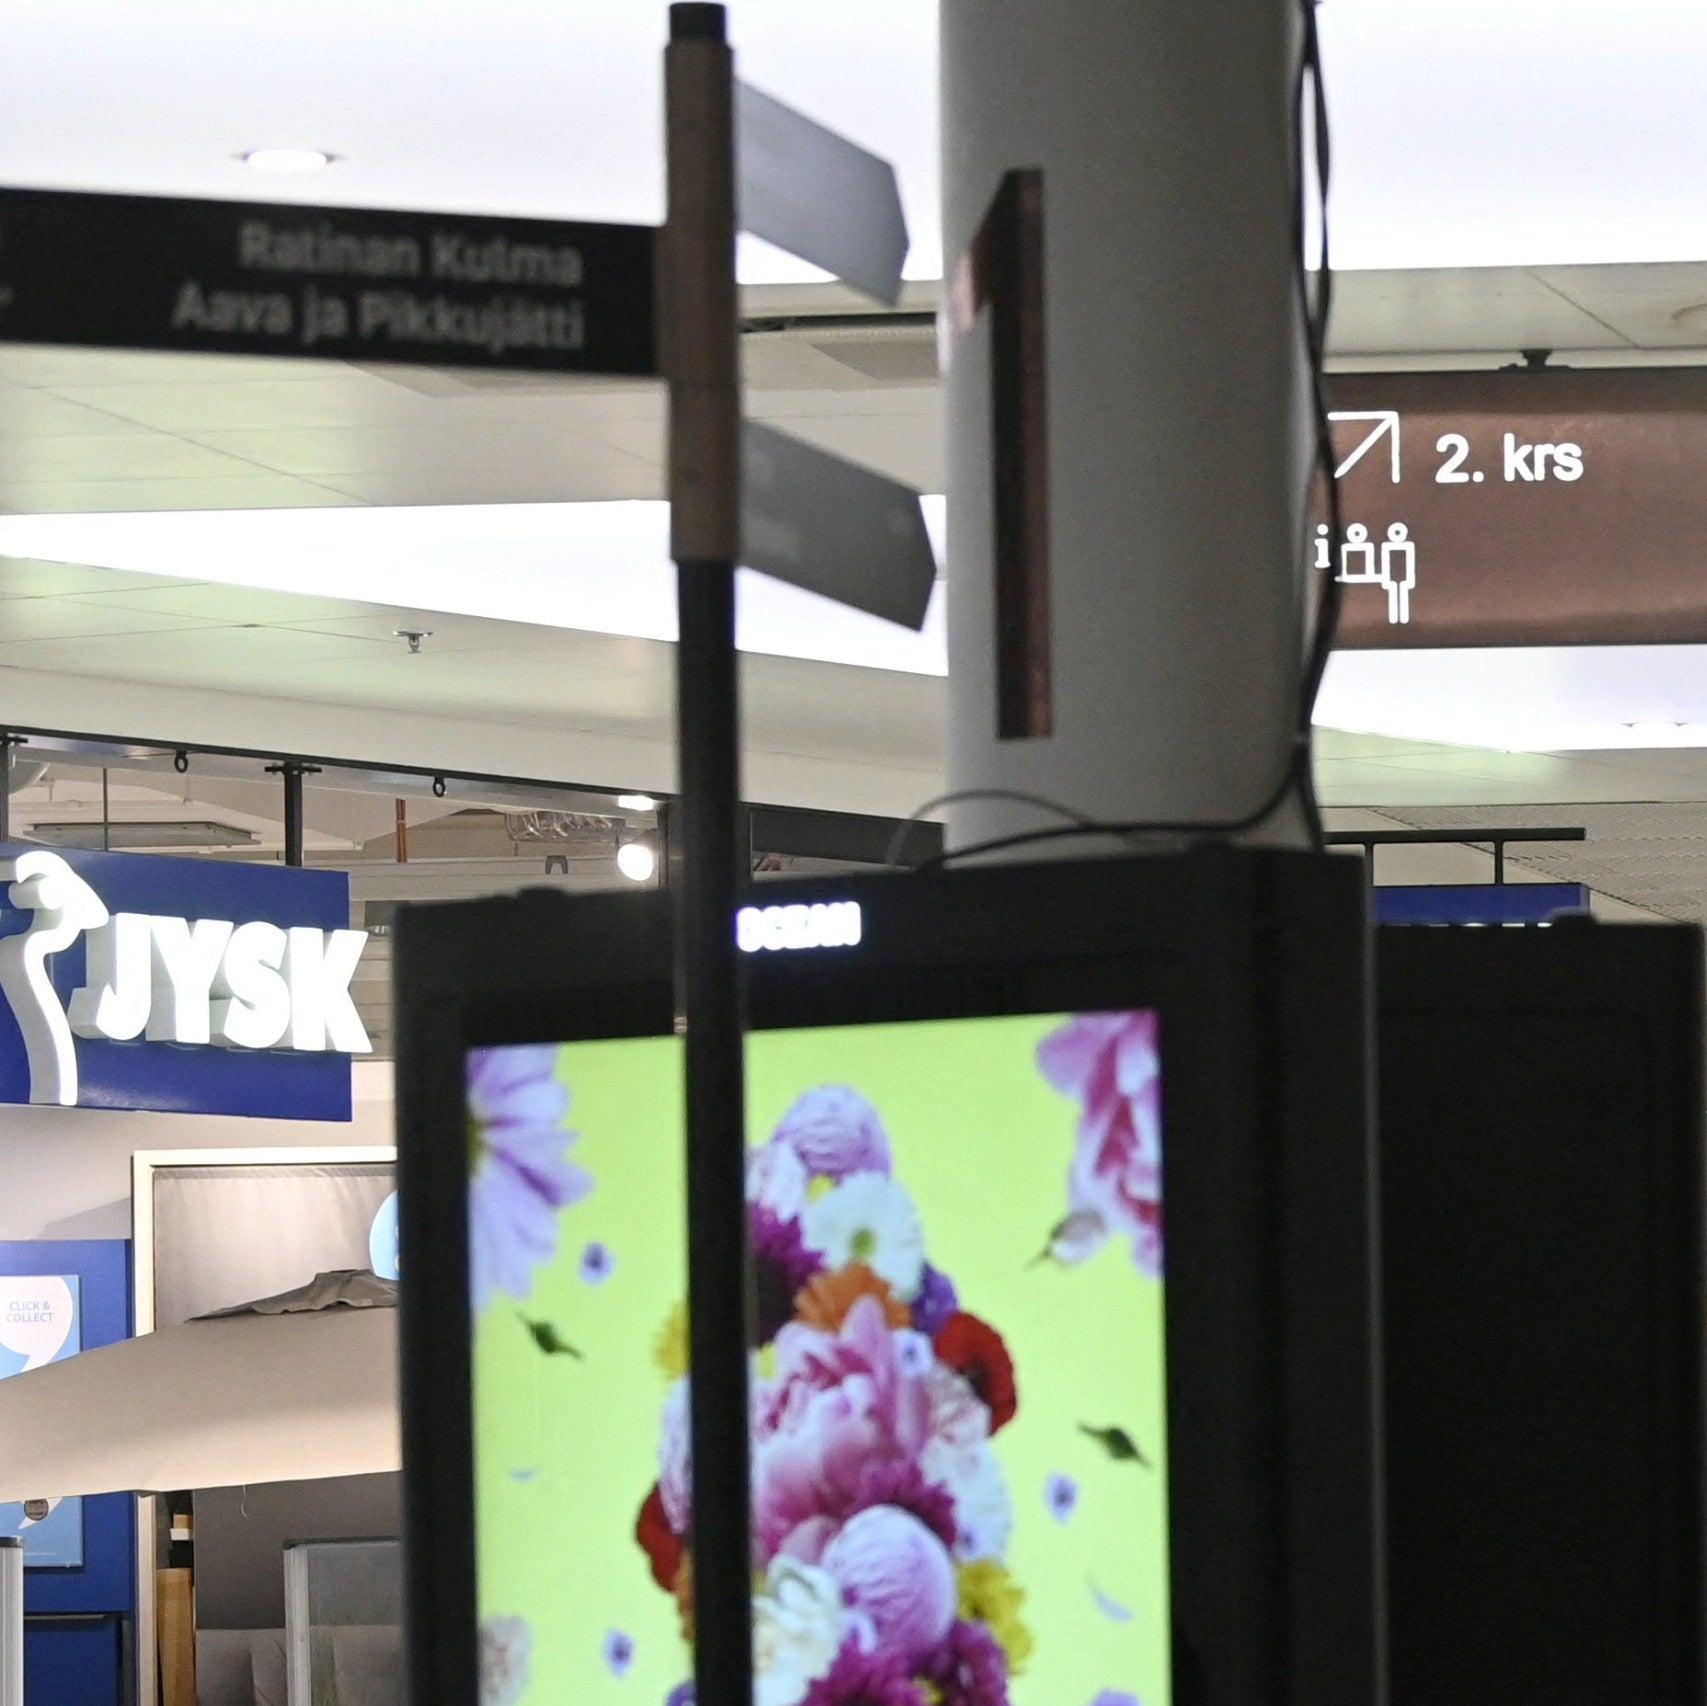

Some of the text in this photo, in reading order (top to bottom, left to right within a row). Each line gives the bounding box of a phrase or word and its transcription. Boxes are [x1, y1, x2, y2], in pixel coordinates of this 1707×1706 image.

[171, 280, 293, 335] Aava
[303, 284, 349, 346] ja
[1435, 432, 1584, 483] 2. krs
[92, 912, 373, 1053] JYSK
[6, 1311, 53, 1323] COLLECT
[9, 1300, 41, 1311] CLICK
